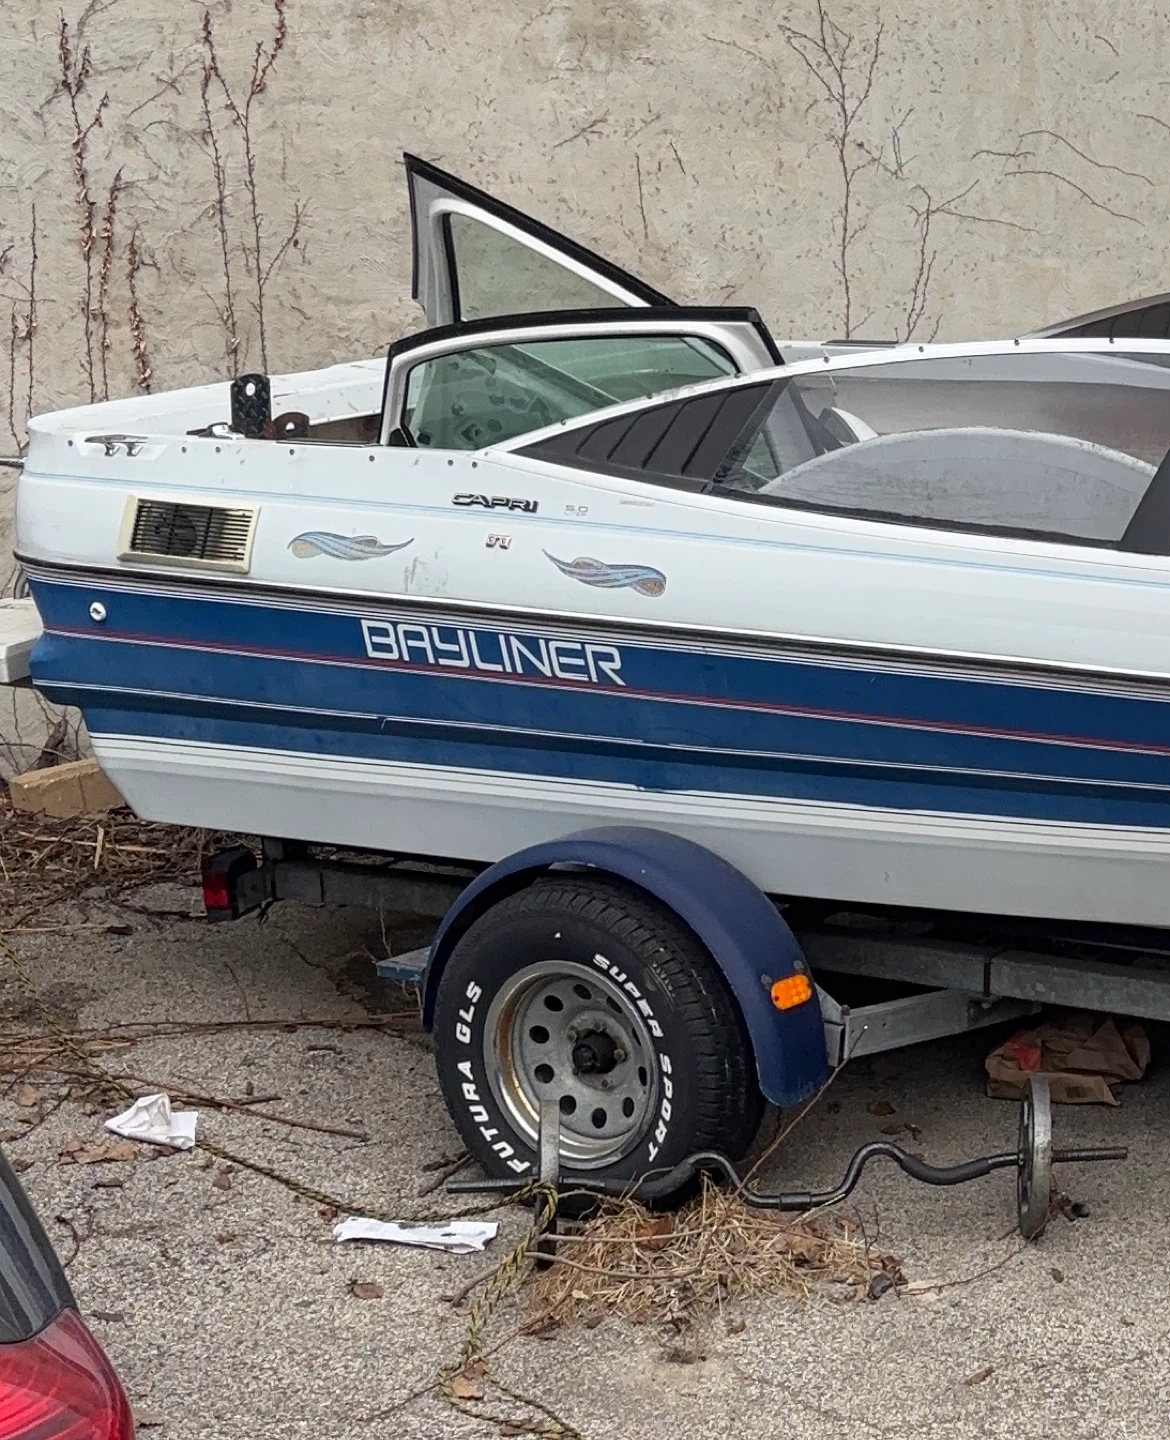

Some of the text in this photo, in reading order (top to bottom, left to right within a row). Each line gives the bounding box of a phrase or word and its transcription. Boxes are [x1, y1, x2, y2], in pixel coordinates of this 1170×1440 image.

[451, 492, 539, 513] CAPRI
[361, 619, 626, 686] BAYLINER
[455, 981, 531, 1173] FUTURA GLS
[592, 953, 673, 1162] SUPER SPORT
